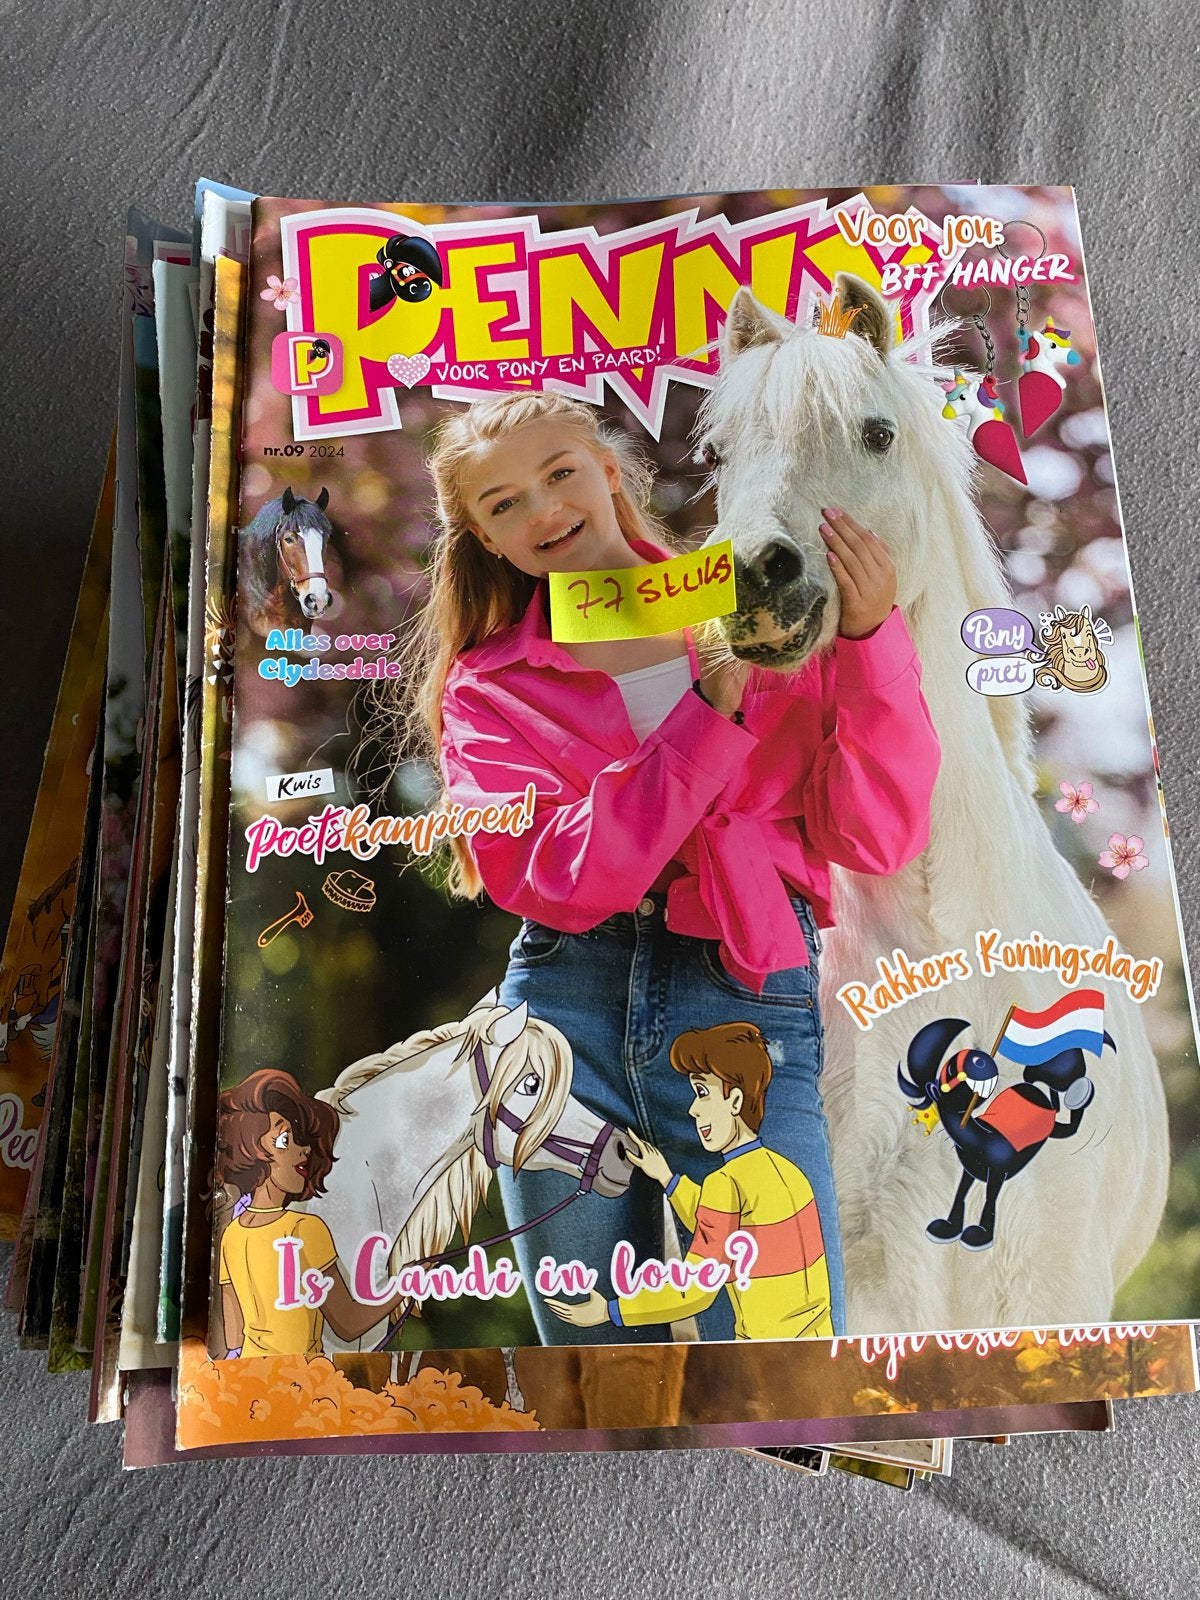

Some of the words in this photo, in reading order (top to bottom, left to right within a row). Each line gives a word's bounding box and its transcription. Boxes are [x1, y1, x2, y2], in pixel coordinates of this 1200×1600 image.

[836, 209, 926, 245] Voor
[940, 216, 1003, 257] jou:
[881, 263, 940, 295] BFF
[953, 254, 1075, 285] HANGER
[294, 208, 946, 430] PENNY
[437, 363, 489, 381] VOOR
[497, 358, 549, 377] PONY
[559, 357, 584, 373] EN
[592, 345, 661, 370] PAARD!
[263, 444, 305, 457] nr.09
[309, 445, 345, 458] 2024
[567, 577, 625, 619] 77
[265, 628, 331, 651] Alles
[335, 633, 396, 651] over
[966, 615, 1025, 649] Pony
[258, 656, 401, 687] Clydesdale
[976, 661, 1027, 691] pret
[277, 775, 321, 798] Kwis
[247, 784, 535, 871] Poetskampioen!
[839, 950, 970, 1028] Rakkers
[977, 930, 1161, 1001] Koningsdag!
[272, 1235, 333, 1309] Is
[354, 1233, 521, 1303] Candi
[537, 1255, 598, 1295] in
[611, 1233, 757, 1297] love?
